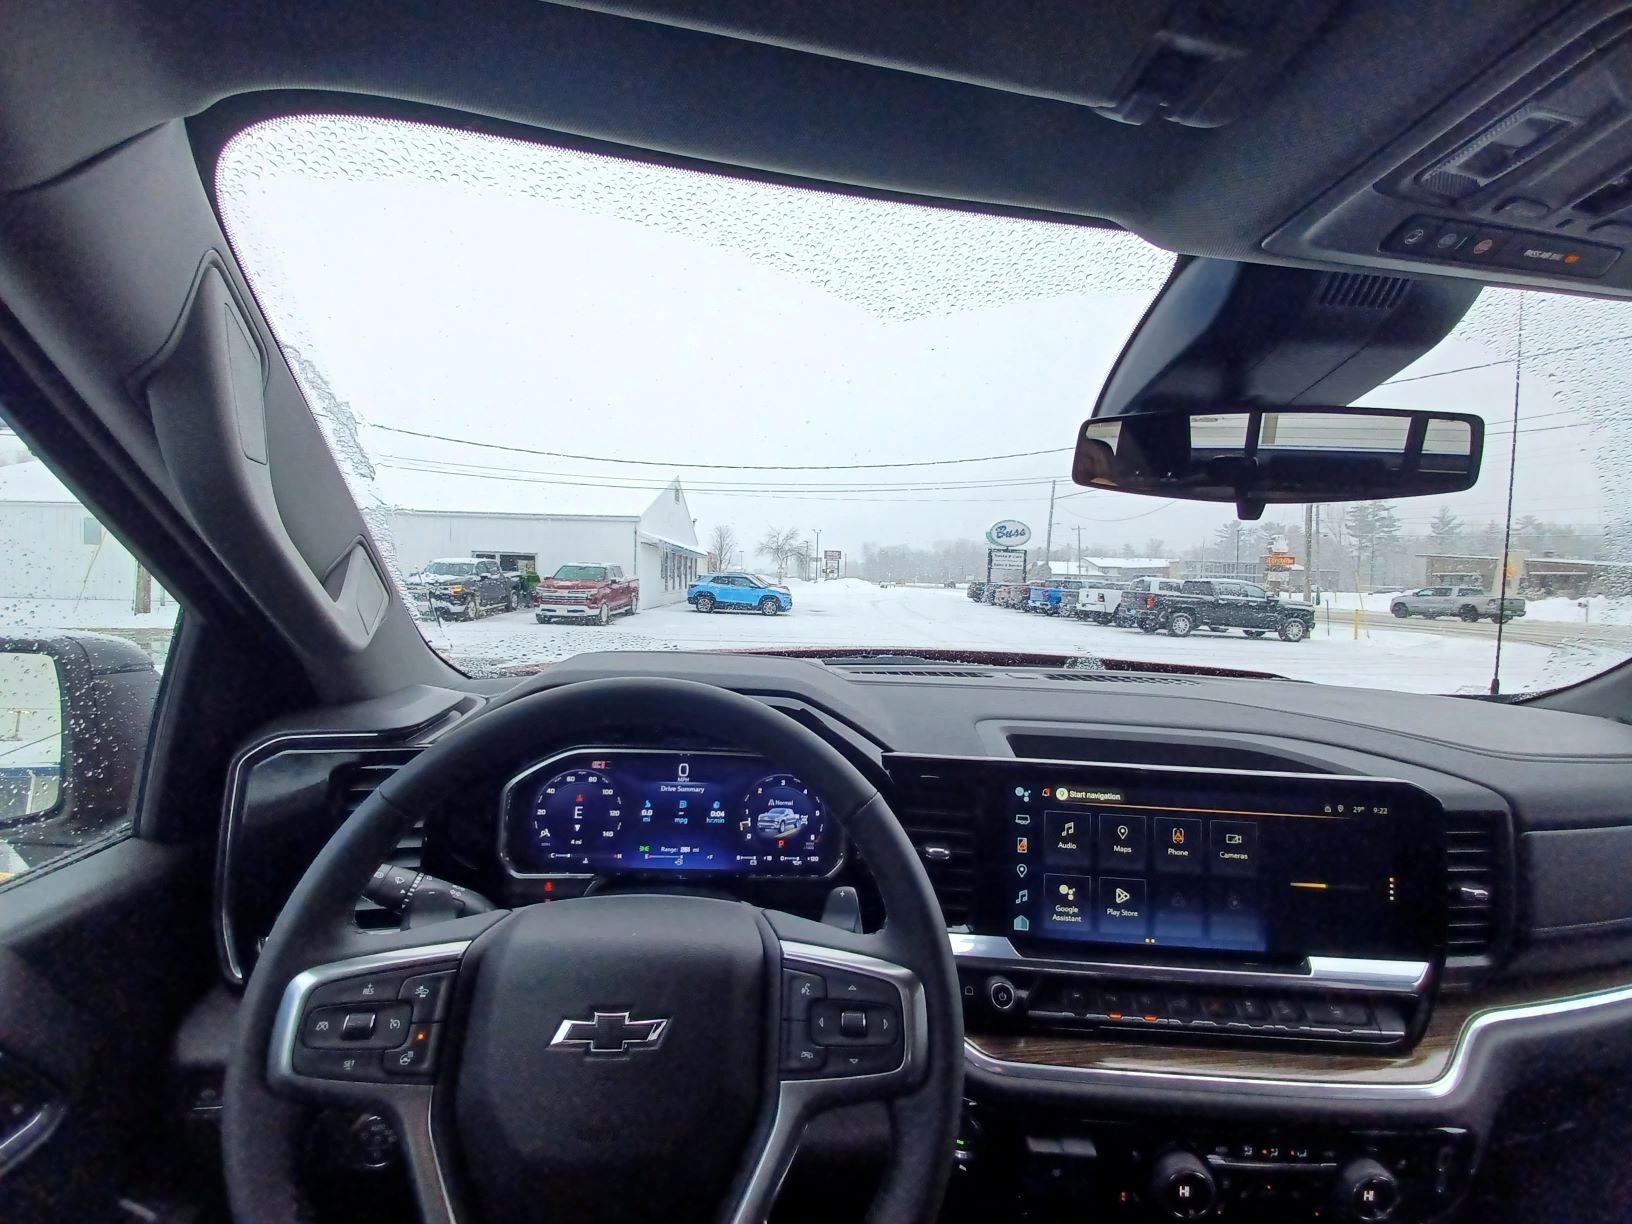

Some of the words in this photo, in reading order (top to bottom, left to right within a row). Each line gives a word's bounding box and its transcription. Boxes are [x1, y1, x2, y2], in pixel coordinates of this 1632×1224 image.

[678, 763, 689, 777] 0
[660, 785, 676, 793] Drive
[677, 785, 705, 794] Summary
[1069, 790, 1085, 799] Start
[1086, 792, 1121, 801] navigation
[537, 808, 546, 816] 20
[574, 806, 583, 819] E
[674, 817, 688, 825] mpg
[778, 839, 785, 848] P
[1057, 841, 1077, 849] Audio
[660, 846, 679, 854] Range:
[1113, 845, 1132, 854] Maps
[1167, 848, 1189, 856] Phone
[1219, 851, 1248, 860] Cameras
[1055, 904, 1079, 913] Google
[1106, 907, 1120, 917] Play
[1121, 909, 1138, 917] Store
[1051, 914, 1082, 922] Assistant
